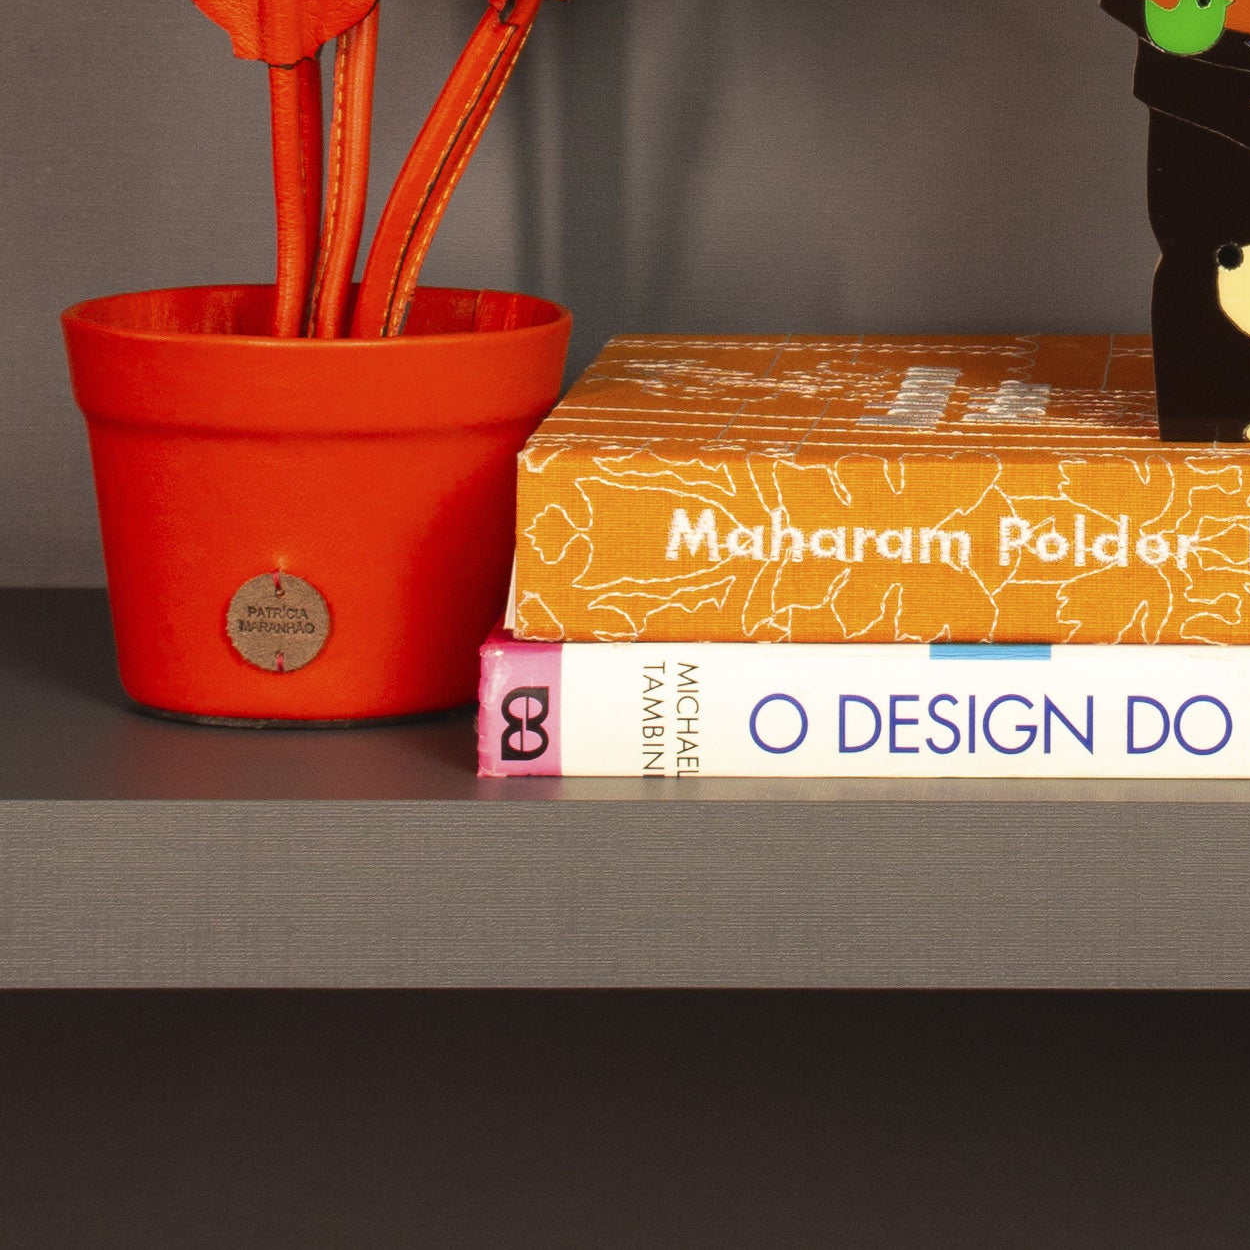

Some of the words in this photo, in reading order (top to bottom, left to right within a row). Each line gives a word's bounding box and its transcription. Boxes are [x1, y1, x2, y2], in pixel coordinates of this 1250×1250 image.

[664, 507, 971, 563] Maharam
[998, 515, 1199, 569] Polder
[676, 662, 700, 779] MICHAEL
[750, 693, 809, 755] O
[838, 693, 1094, 755] DESIGN
[1126, 694, 1233, 756] DO
